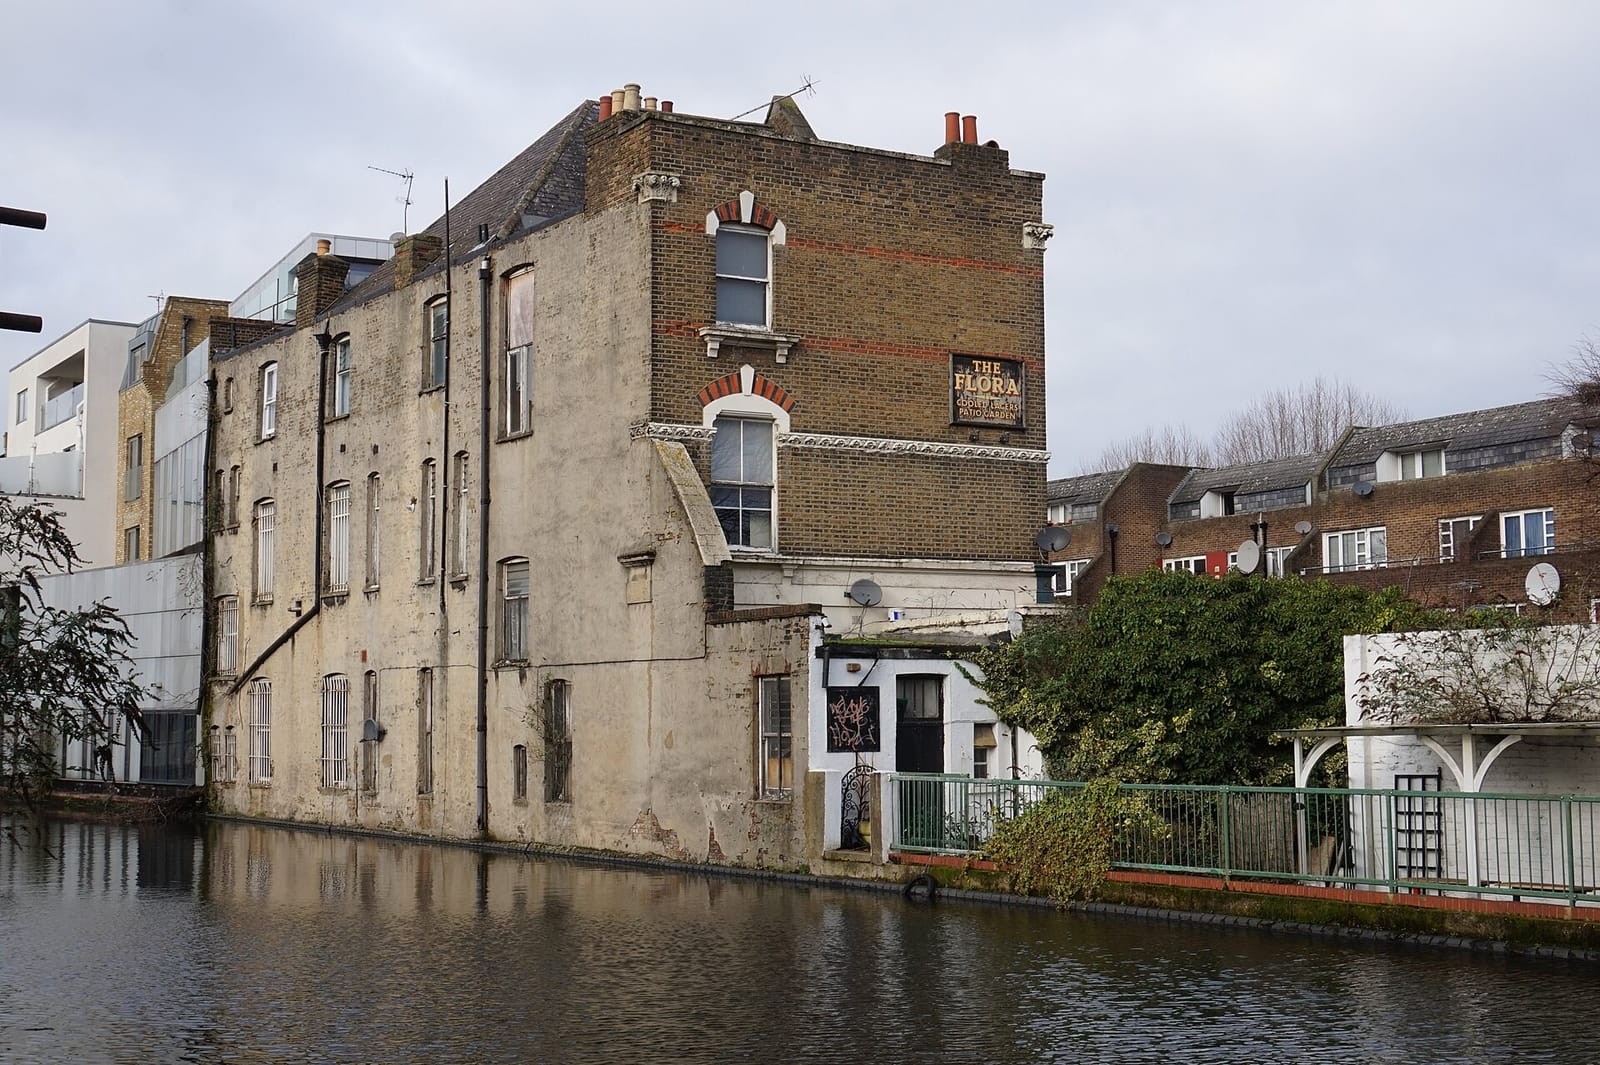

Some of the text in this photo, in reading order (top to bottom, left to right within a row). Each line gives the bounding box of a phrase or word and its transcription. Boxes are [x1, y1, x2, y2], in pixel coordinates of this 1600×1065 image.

[972, 360, 1001, 375] THE
[954, 373, 1020, 396] FLORA
[956, 398, 1019, 412] COOLED LAGERS
[959, 407, 1016, 420] PATIO GARDEN
